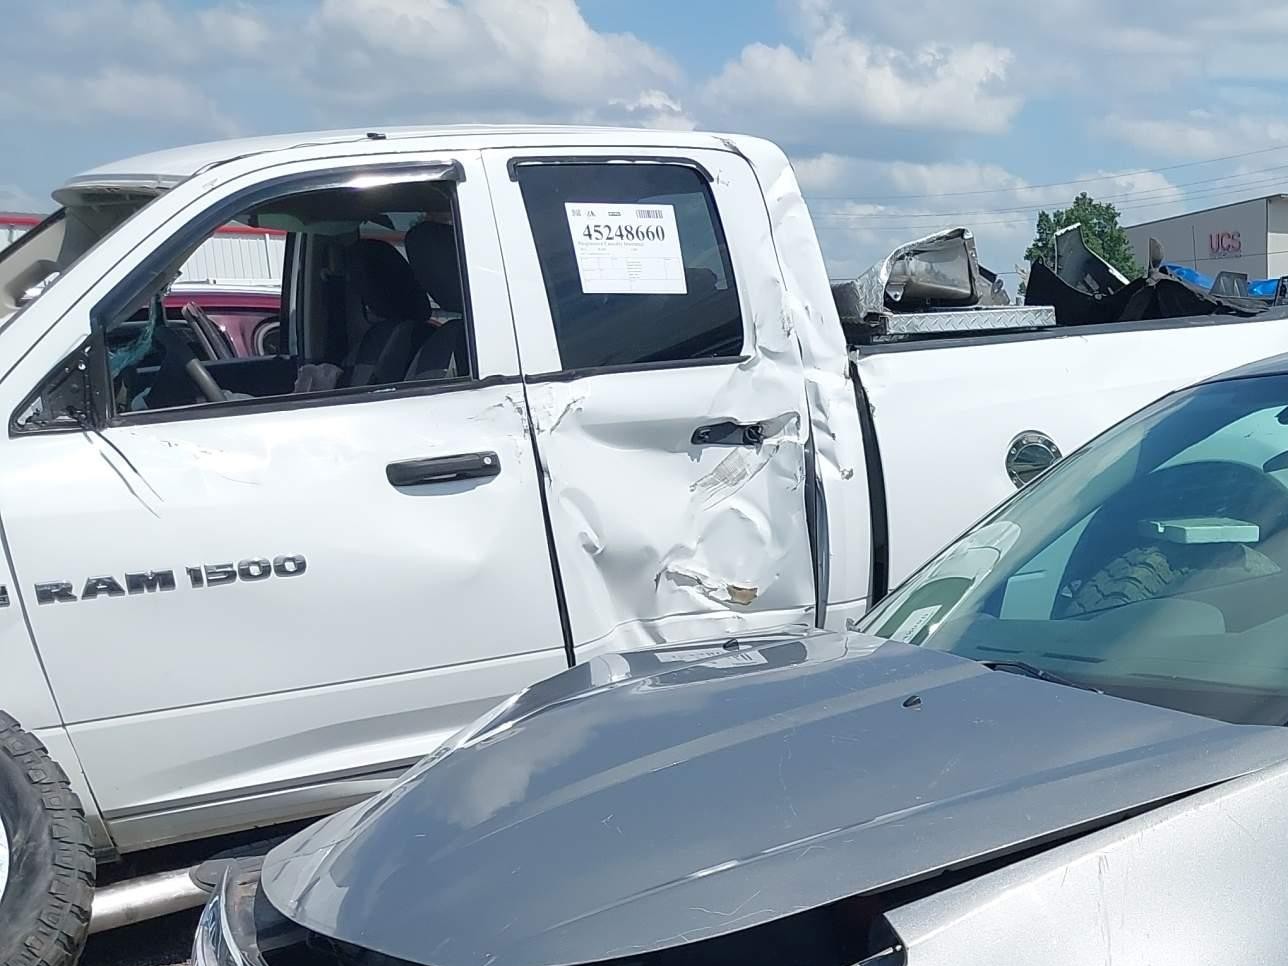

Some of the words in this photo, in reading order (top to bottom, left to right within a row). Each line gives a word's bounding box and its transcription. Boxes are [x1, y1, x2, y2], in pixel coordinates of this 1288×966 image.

[582, 224, 665, 242] 45248660
[1210, 231, 1242, 252] UCS
[34, 568, 177, 606] RAM
[185, 553, 308, 589] 1500
